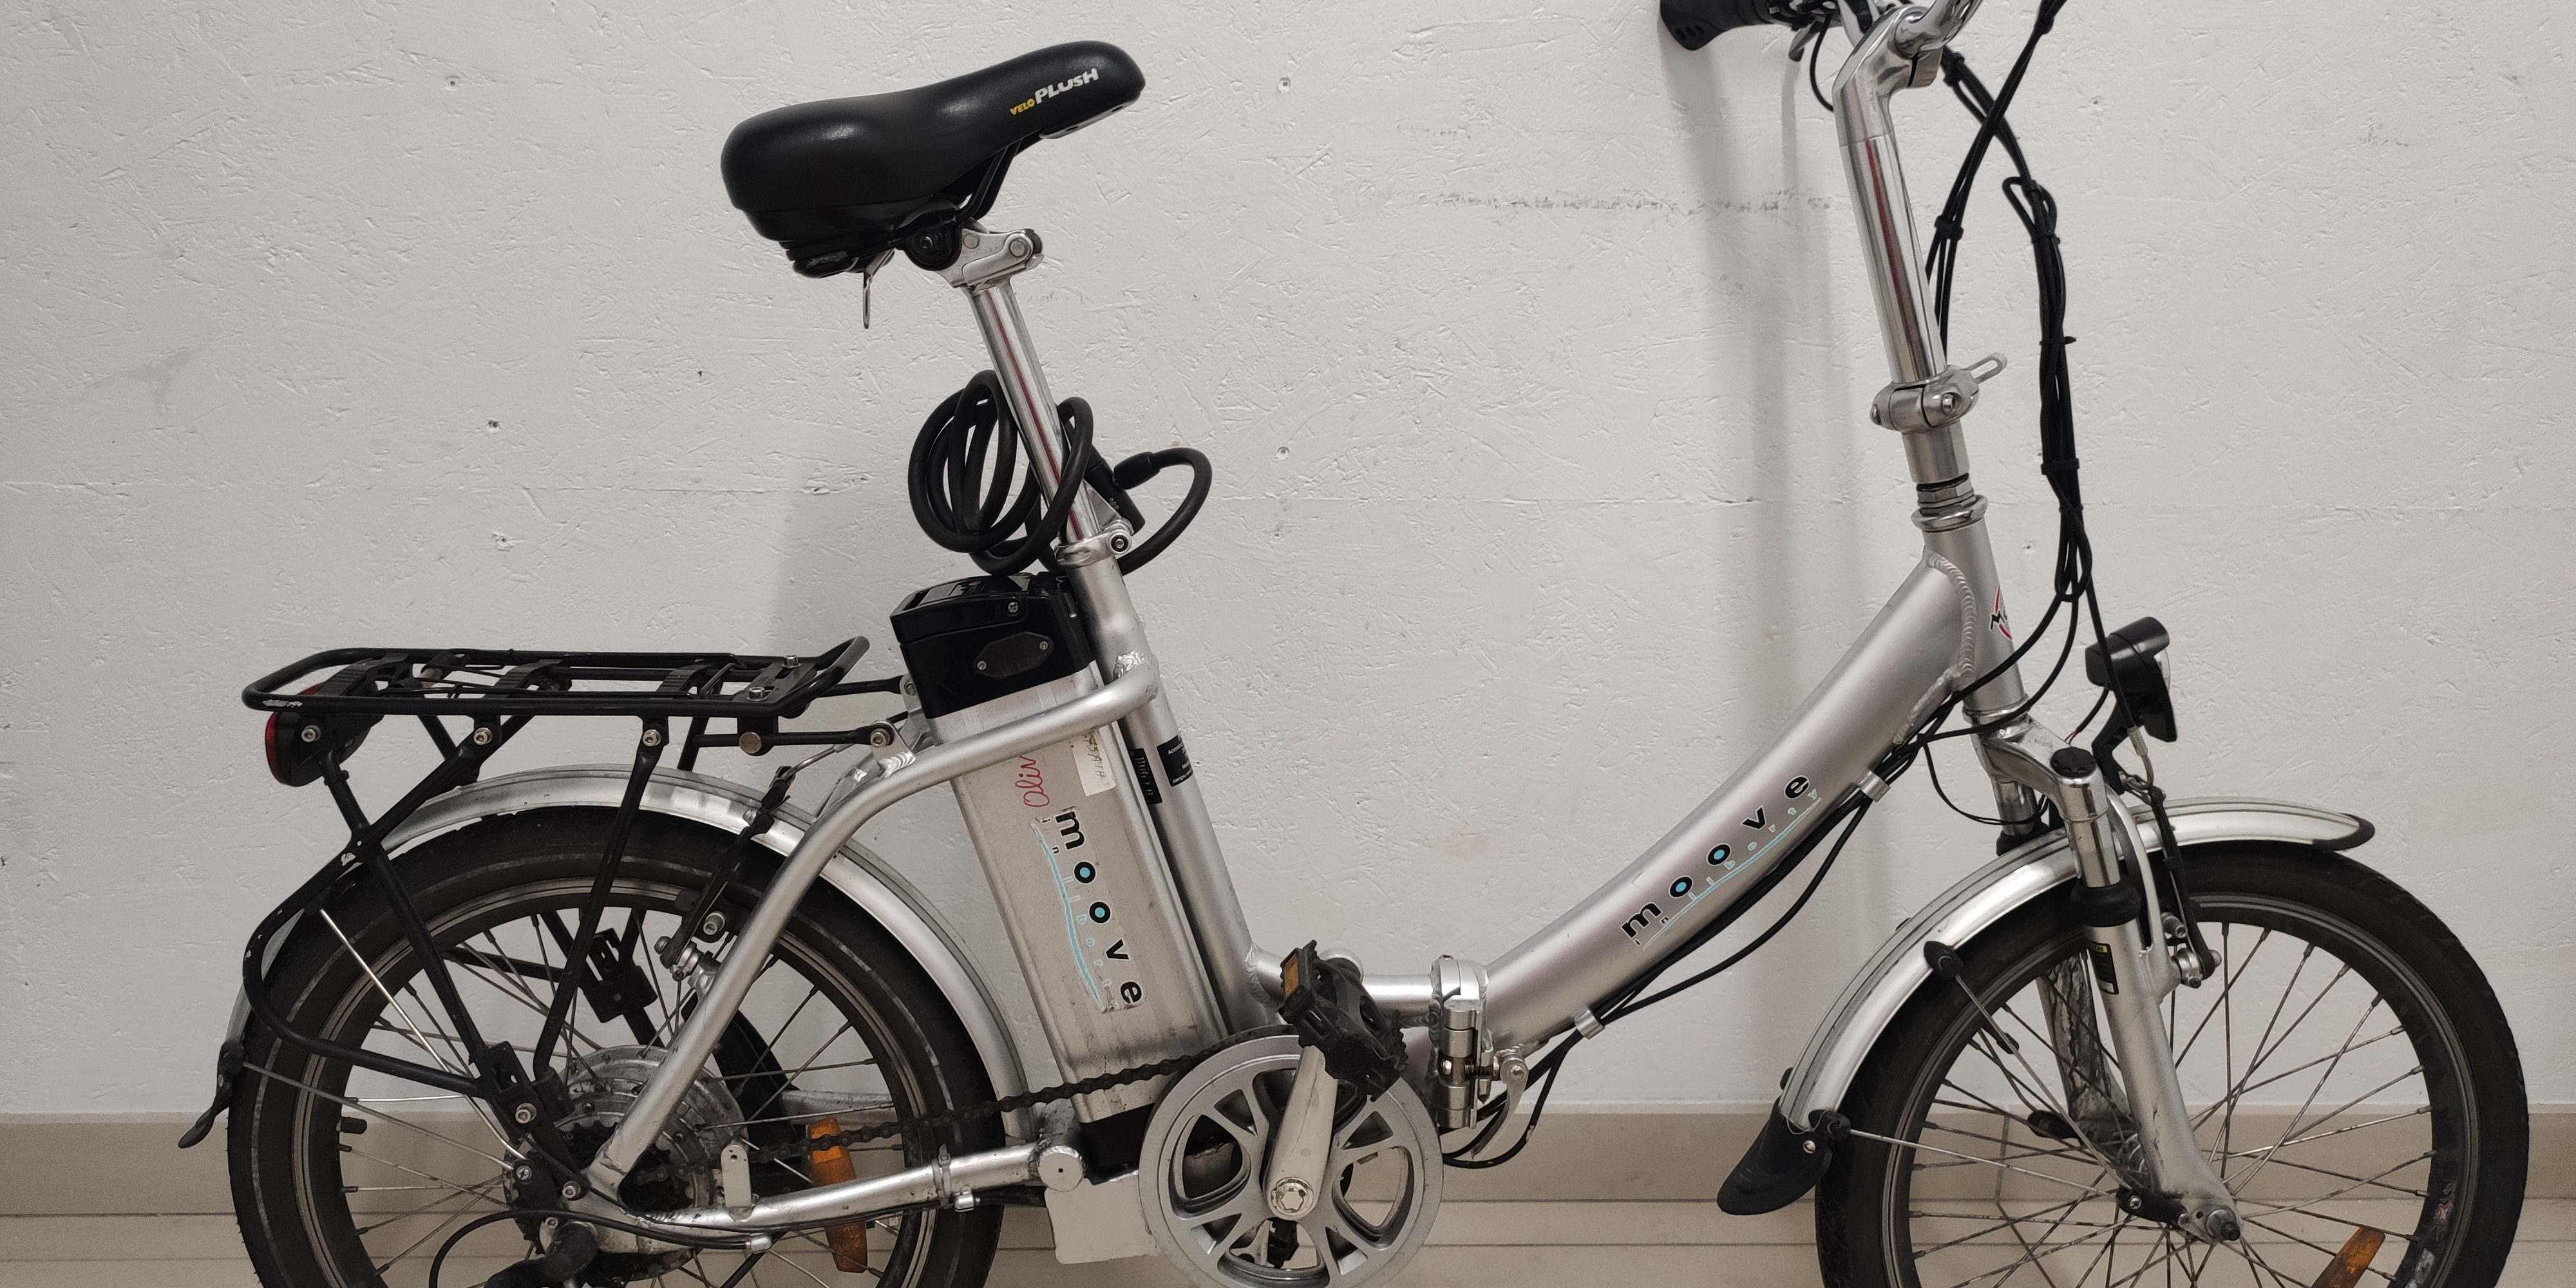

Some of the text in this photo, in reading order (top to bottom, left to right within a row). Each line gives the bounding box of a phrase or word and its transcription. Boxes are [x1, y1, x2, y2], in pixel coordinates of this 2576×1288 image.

[1009, 67, 1100, 116] VELO PLUSH
[1055, 810, 1142, 1004] moove
[1620, 775, 1810, 939] moove
